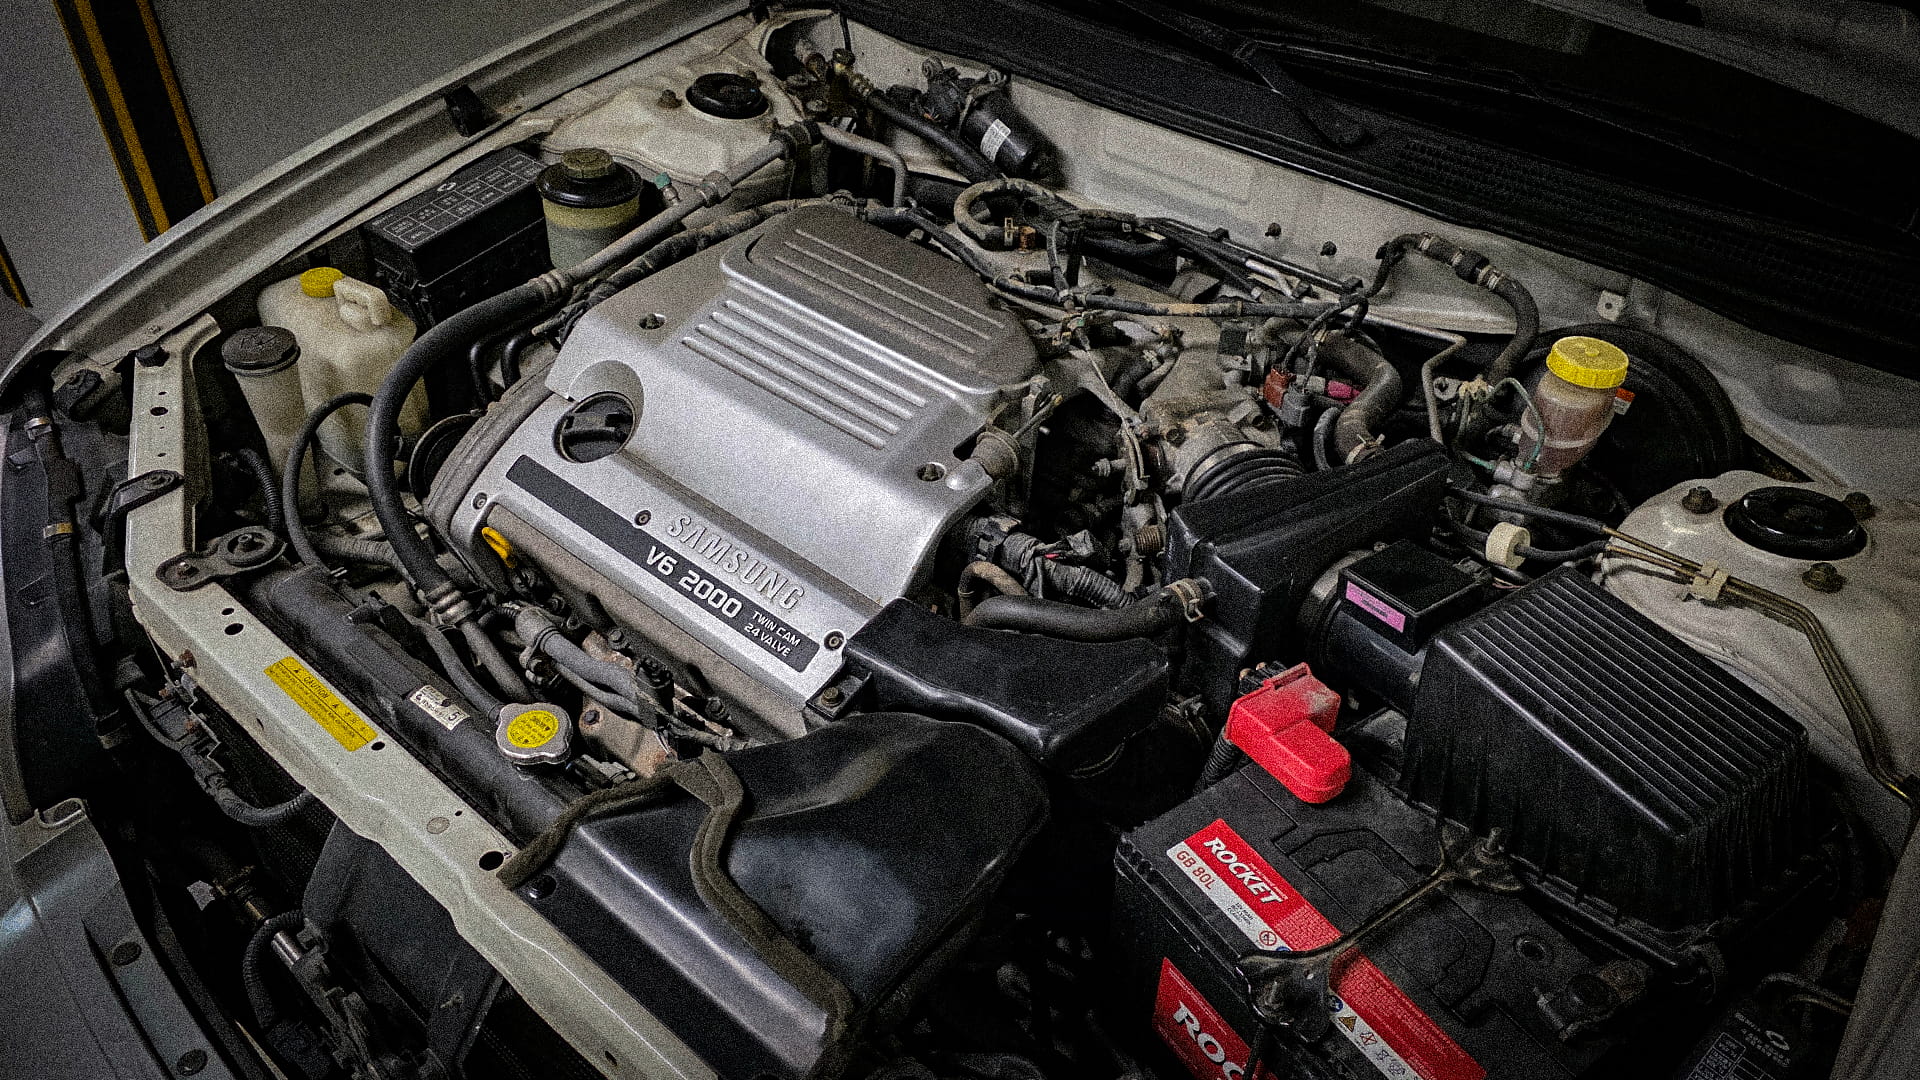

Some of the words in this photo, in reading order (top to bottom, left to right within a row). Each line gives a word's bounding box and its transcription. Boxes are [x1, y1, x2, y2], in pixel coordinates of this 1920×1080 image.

[646, 545, 678, 576] V6
[679, 569, 743, 618] 2000
[667, 514, 805, 610] SAMSUNG
[744, 622, 761, 637] 24
[760, 632, 791, 657] VALVE
[752, 610, 778, 631] TWIN
[776, 627, 801, 647] CAM
[303, 676, 330, 699] CAUTION
[1176, 850, 1197, 868] GB
[1192, 867, 1217, 890] 80L
[1203, 837, 1284, 904] ROCKET
